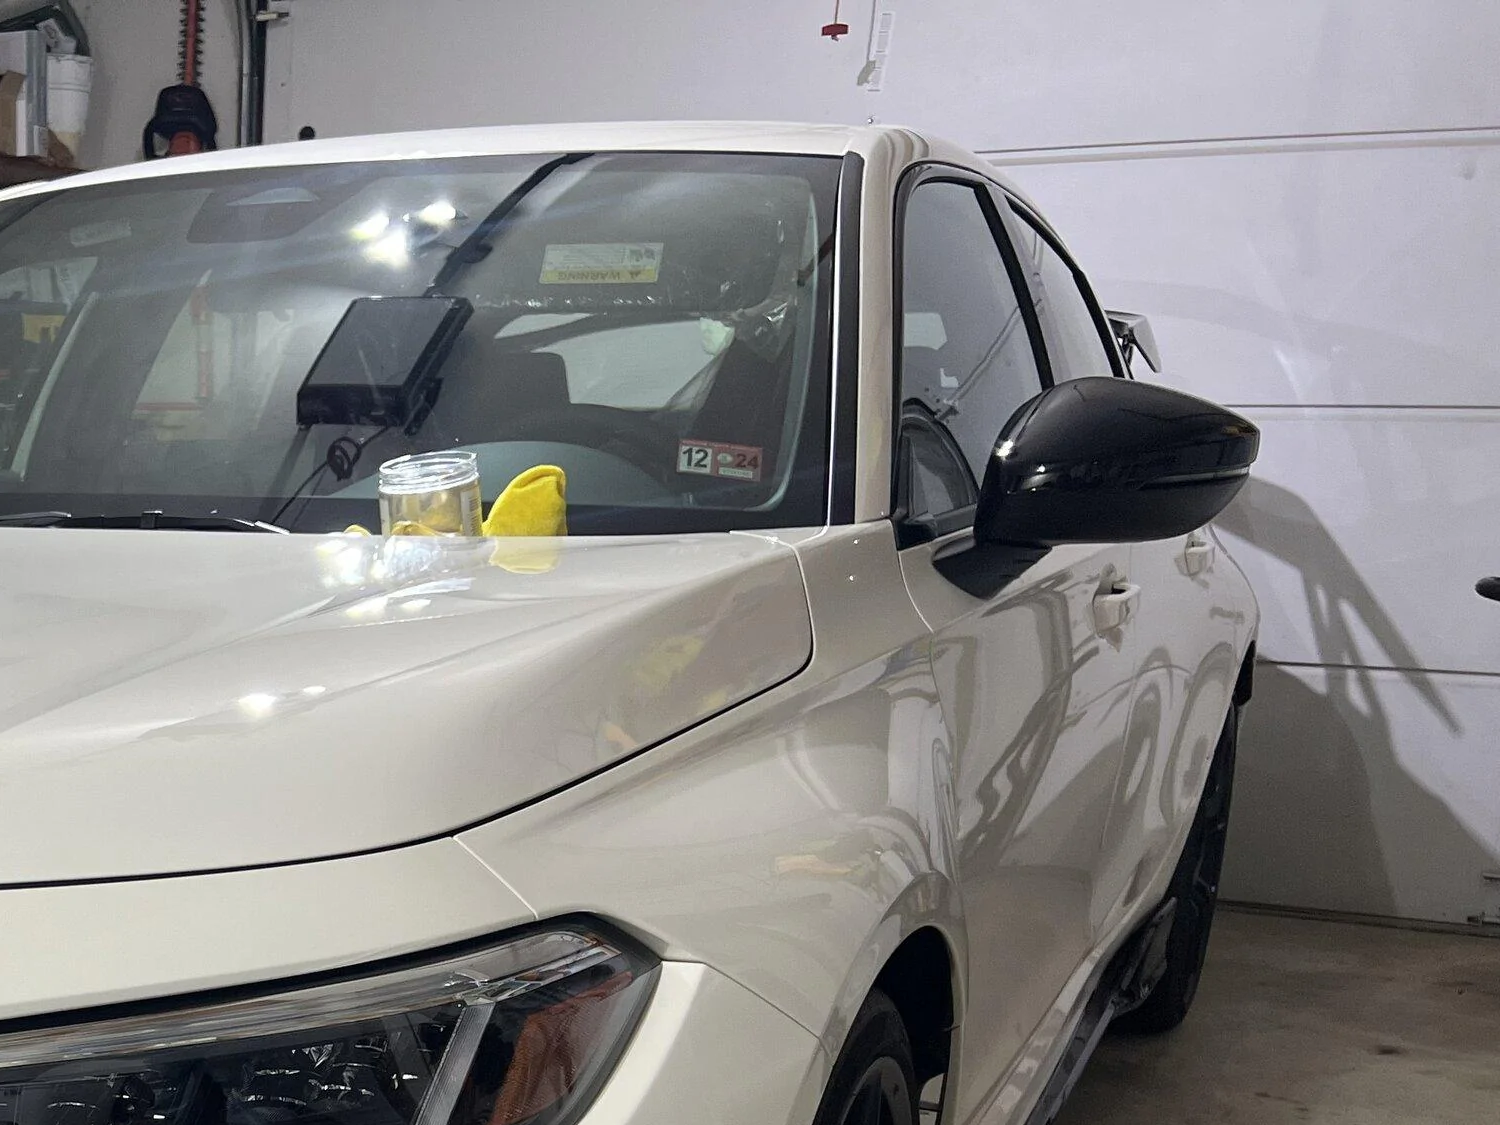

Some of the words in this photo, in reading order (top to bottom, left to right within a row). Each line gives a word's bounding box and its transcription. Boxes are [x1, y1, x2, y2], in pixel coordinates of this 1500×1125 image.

[557, 269, 621, 281] WARNING
[681, 446, 709, 470] 12
[735, 453, 759, 471] 24
